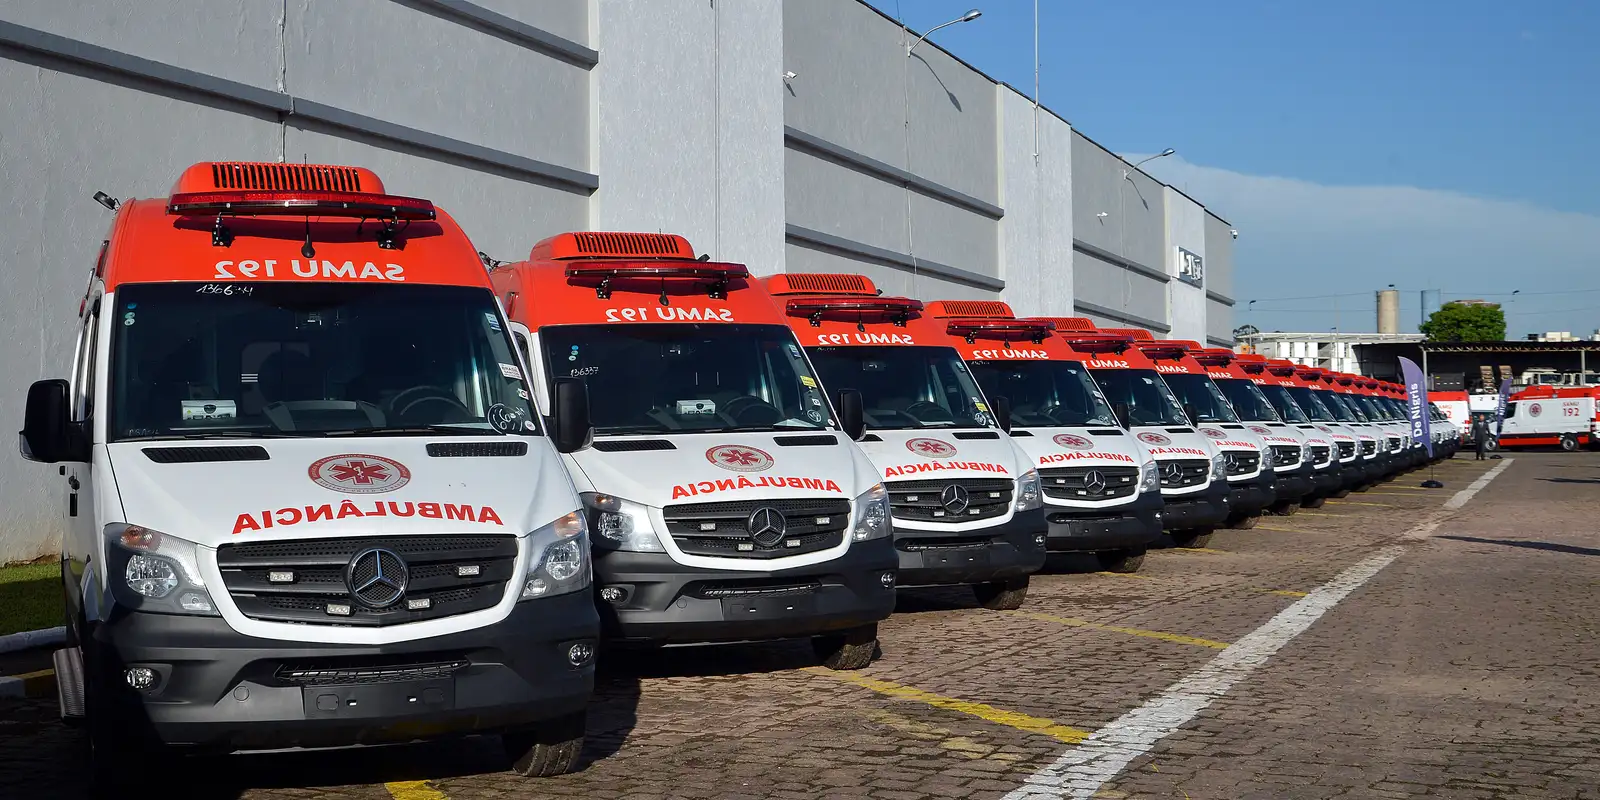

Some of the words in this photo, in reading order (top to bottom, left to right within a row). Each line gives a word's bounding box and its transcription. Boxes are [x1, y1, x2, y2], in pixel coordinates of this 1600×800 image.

[1409, 383, 1421, 420] Nigris
[1563, 407, 1580, 417] 192
[1413, 421, 1423, 438] De
